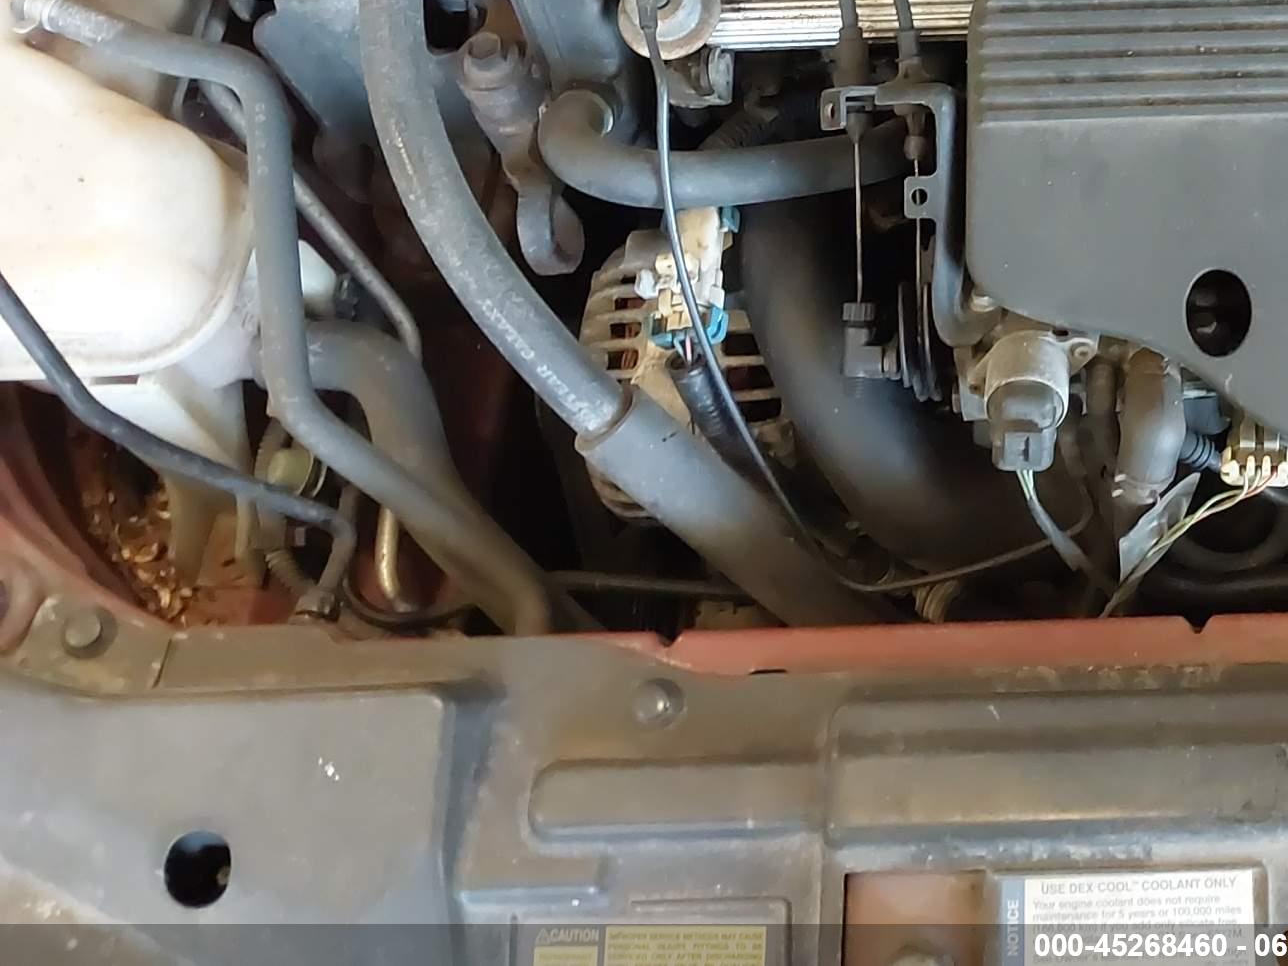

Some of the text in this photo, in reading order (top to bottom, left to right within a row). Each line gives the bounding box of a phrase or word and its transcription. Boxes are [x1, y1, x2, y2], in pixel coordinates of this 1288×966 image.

[1040, 882, 1065, 896] USE
[1069, 881, 1093, 894] DEX
[1141, 877, 1201, 892] COOLANT
[1204, 876, 1238, 890] ONLY
[1095, 896, 1134, 908] coolant
[550, 928, 599, 943] CAUTION
[1007, 898, 1019, 957] NOTICE
